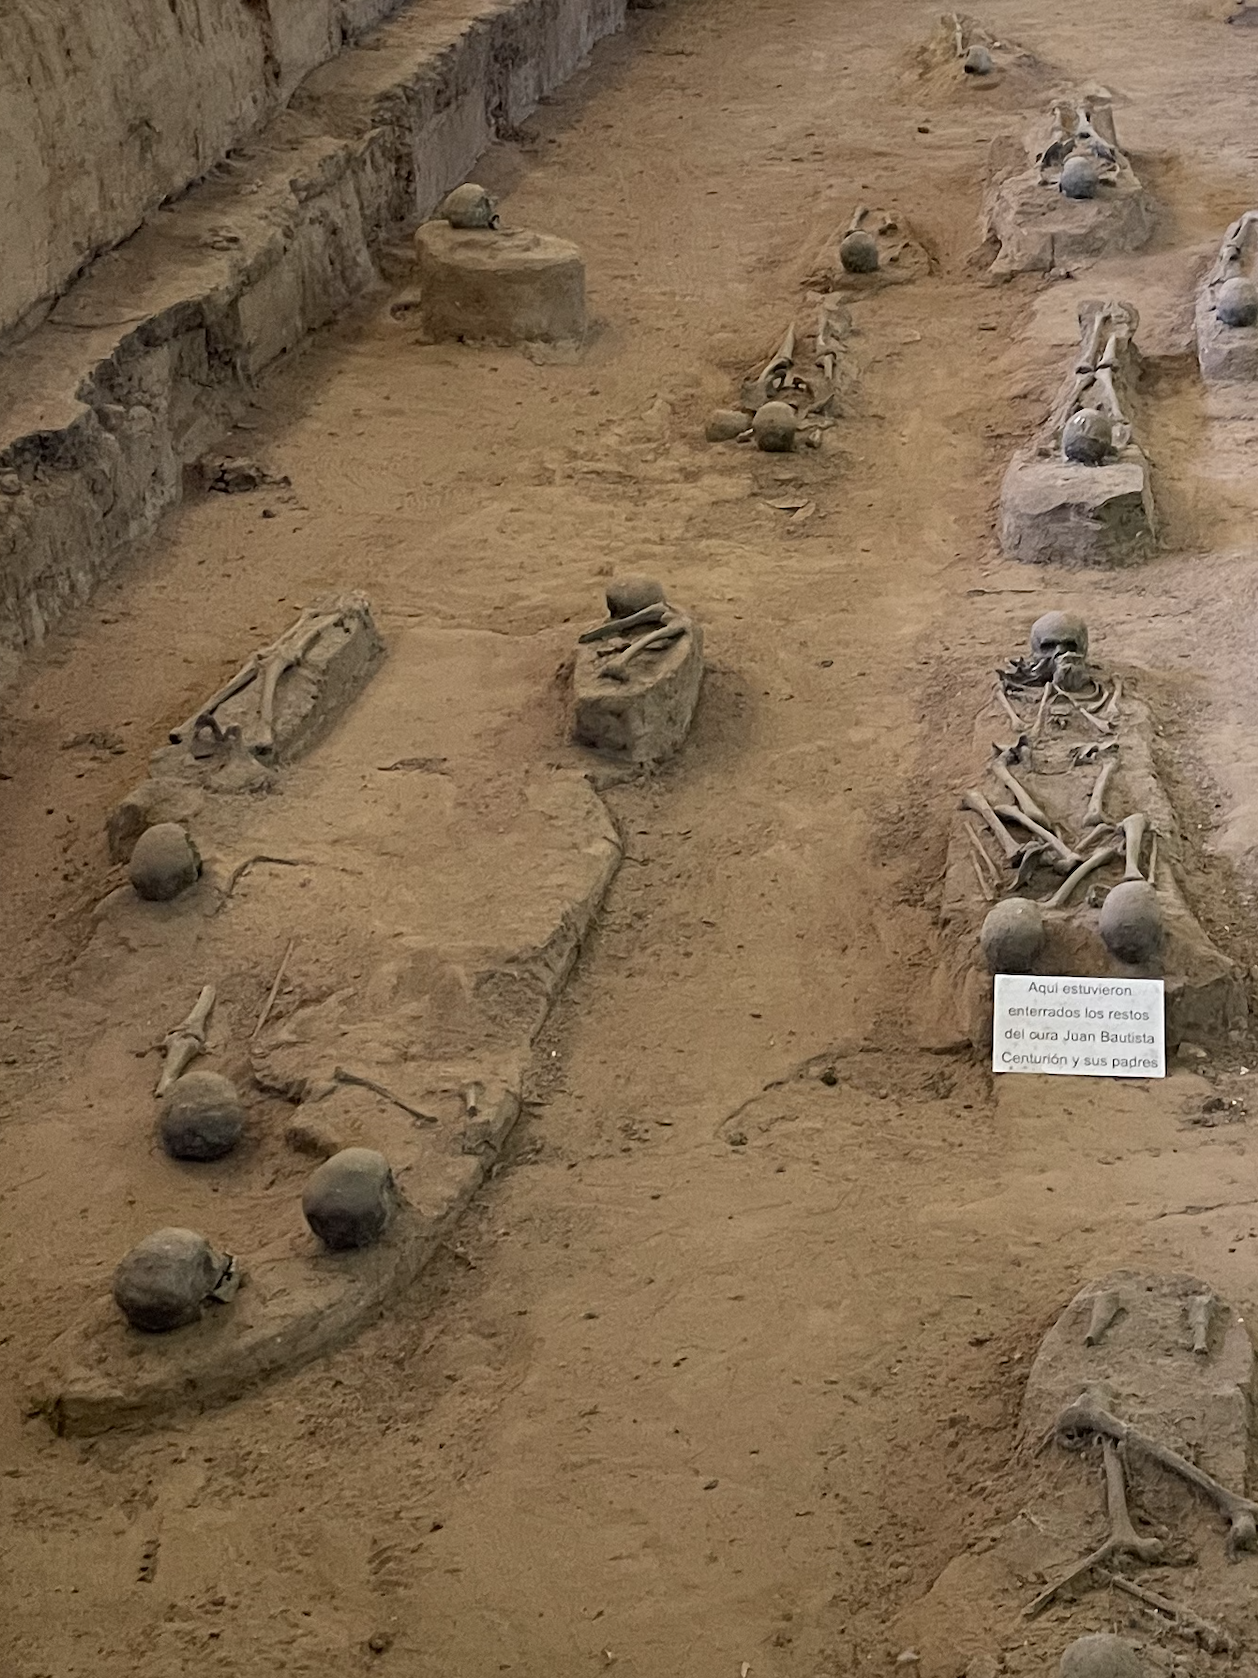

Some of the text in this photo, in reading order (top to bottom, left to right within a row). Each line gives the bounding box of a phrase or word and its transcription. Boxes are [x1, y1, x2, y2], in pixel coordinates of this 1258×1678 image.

[1063, 984, 1132, 996] estuvieron
[1008, 1007, 1150, 1021] enterrados los restos
[1004, 1028, 1155, 1044] del cura Juan Bautista
[1001, 1051, 1159, 1069] Centurión y sus padres
